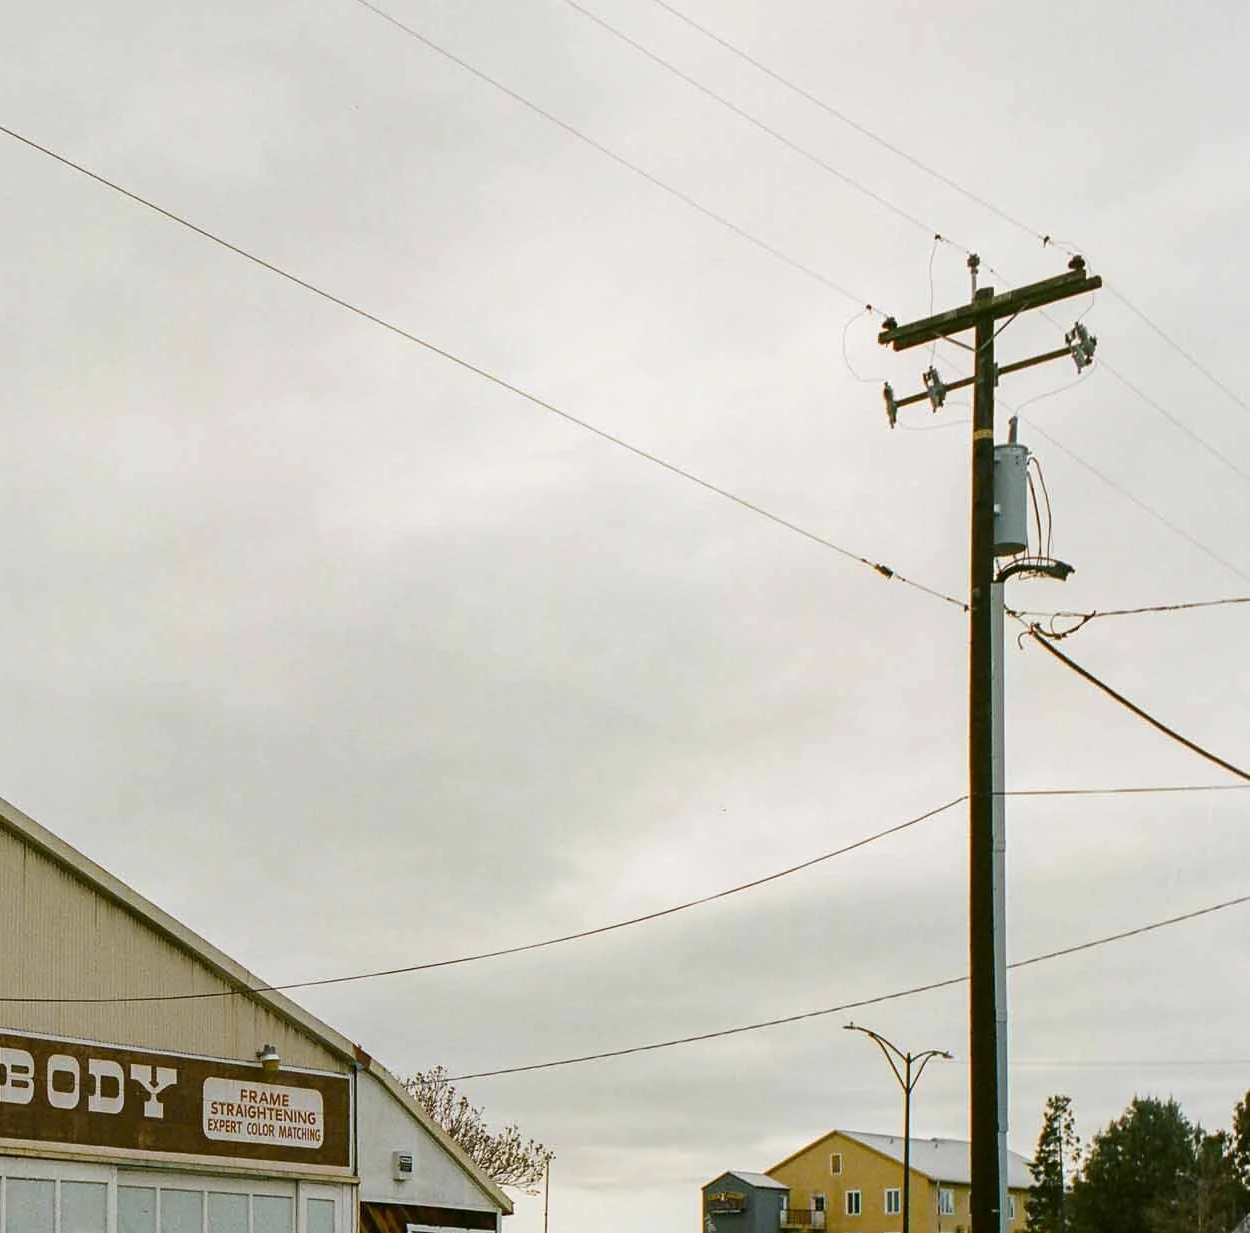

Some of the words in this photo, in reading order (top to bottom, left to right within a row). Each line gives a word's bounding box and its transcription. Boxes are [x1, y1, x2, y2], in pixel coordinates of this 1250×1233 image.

[240, 1089, 289, 1107] FRAME
[211, 1102, 317, 1125] STRAIGHTENING
[208, 1118, 243, 1136] EXPERT
[247, 1122, 275, 1138] COLOR
[279, 1125, 321, 1142] MATCHING
